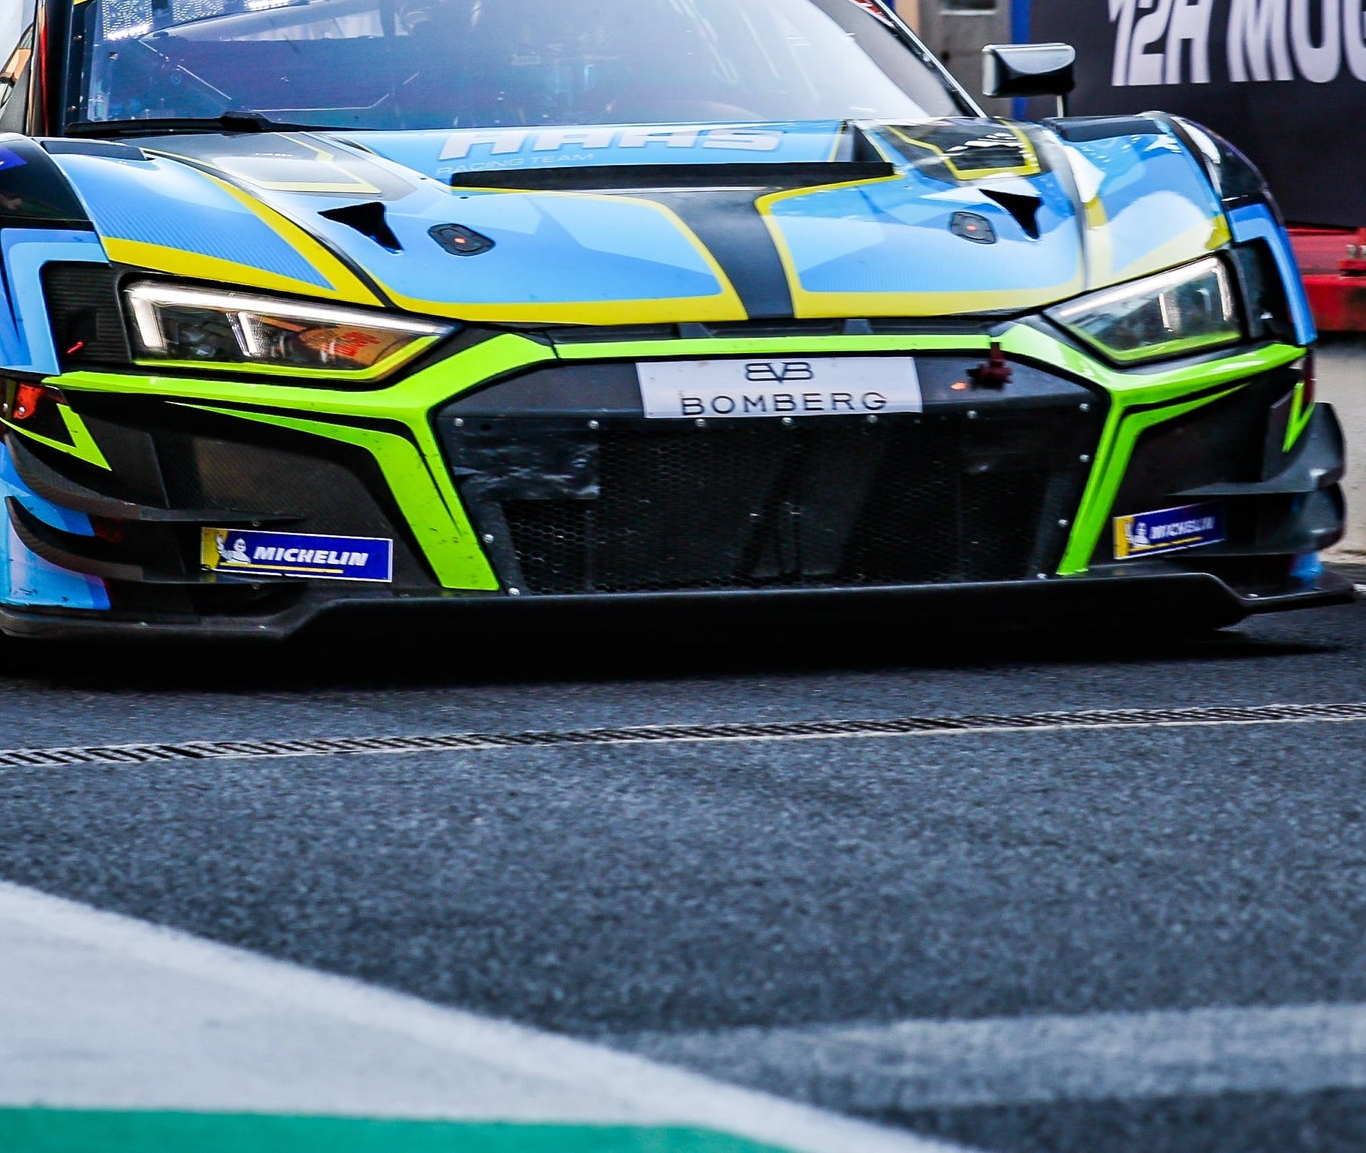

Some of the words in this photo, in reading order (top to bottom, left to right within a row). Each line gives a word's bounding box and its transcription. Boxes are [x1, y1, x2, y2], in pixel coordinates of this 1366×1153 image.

[437, 128, 786, 161] HAAS
[436, 157, 525, 176] RACING
[529, 152, 595, 165] TEAM
[680, 391, 888, 416] BOMBERG
[252, 545, 370, 567] MICHELIN
